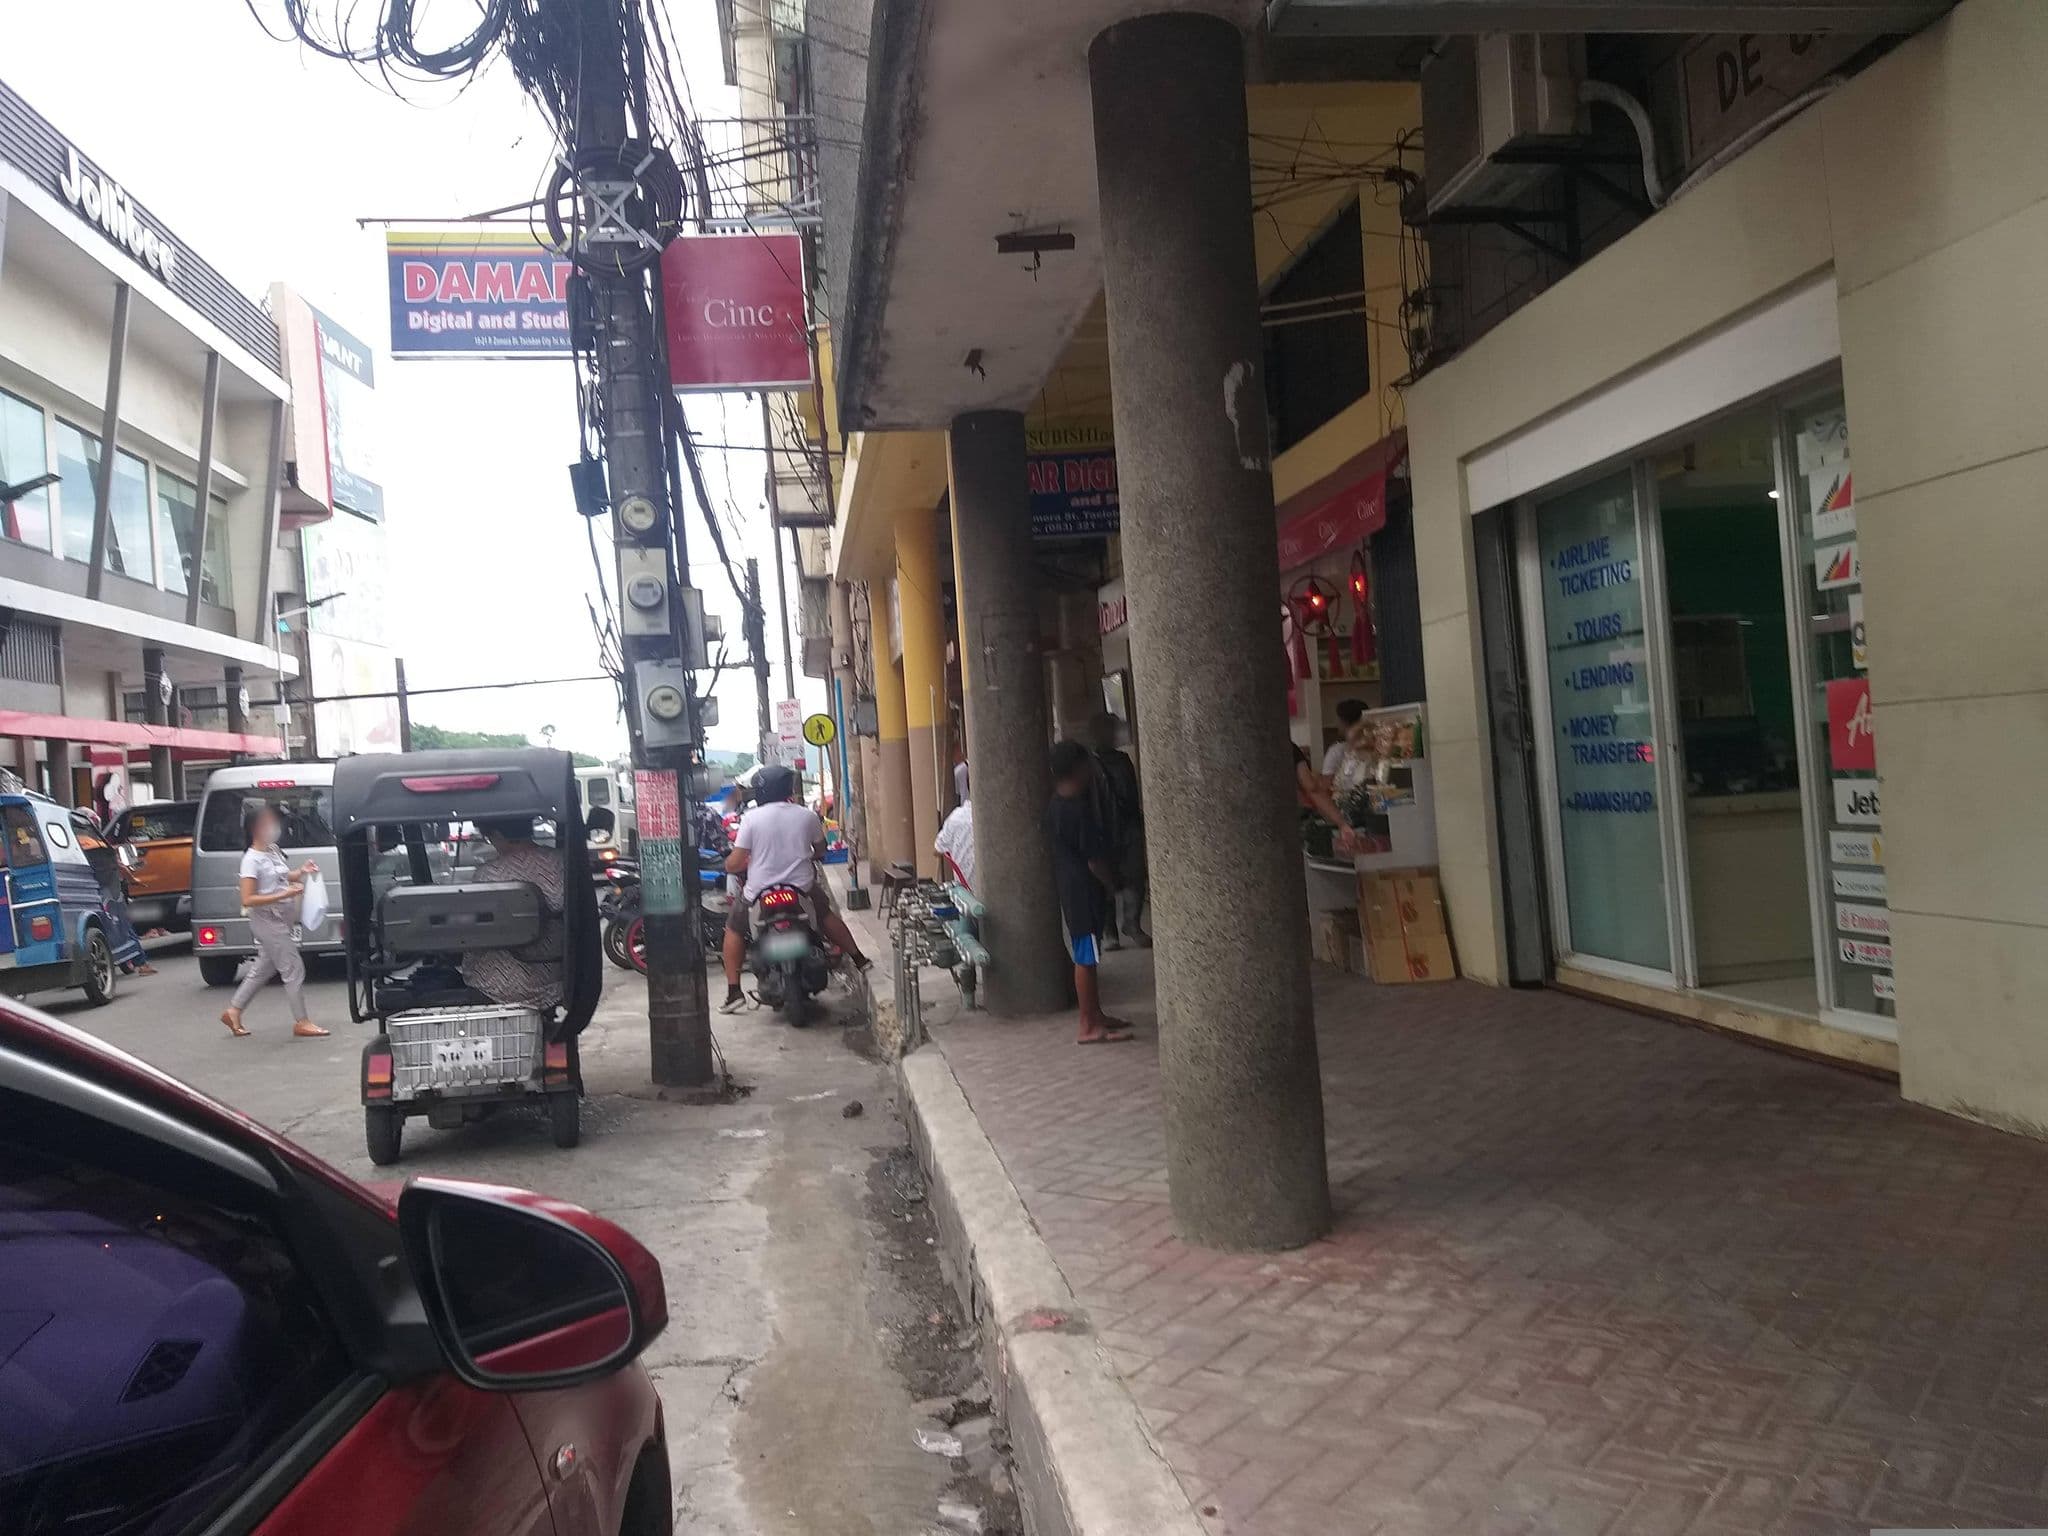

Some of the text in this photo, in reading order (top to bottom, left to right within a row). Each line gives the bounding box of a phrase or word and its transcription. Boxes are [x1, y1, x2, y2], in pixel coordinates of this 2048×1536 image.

[1716, 34, 1763, 113] DE
[60, 146, 175, 283] Jollibee
[408, 309, 473, 333] Digital
[478, 310, 516, 330] and
[1027, 428, 1099, 447] SUBISHI
[1558, 536, 1610, 571] AIRLINE
[1559, 560, 1631, 598] TICKETING
[1574, 612, 1622, 641] TOURS
[1572, 662, 1634, 691] LENDING
[1570, 713, 1618, 738] MONEY
[1571, 741, 1648, 765] TRANSFER
[1573, 790, 1653, 813] PAWNSHOP
[1848, 789, 1880, 816] Jet
